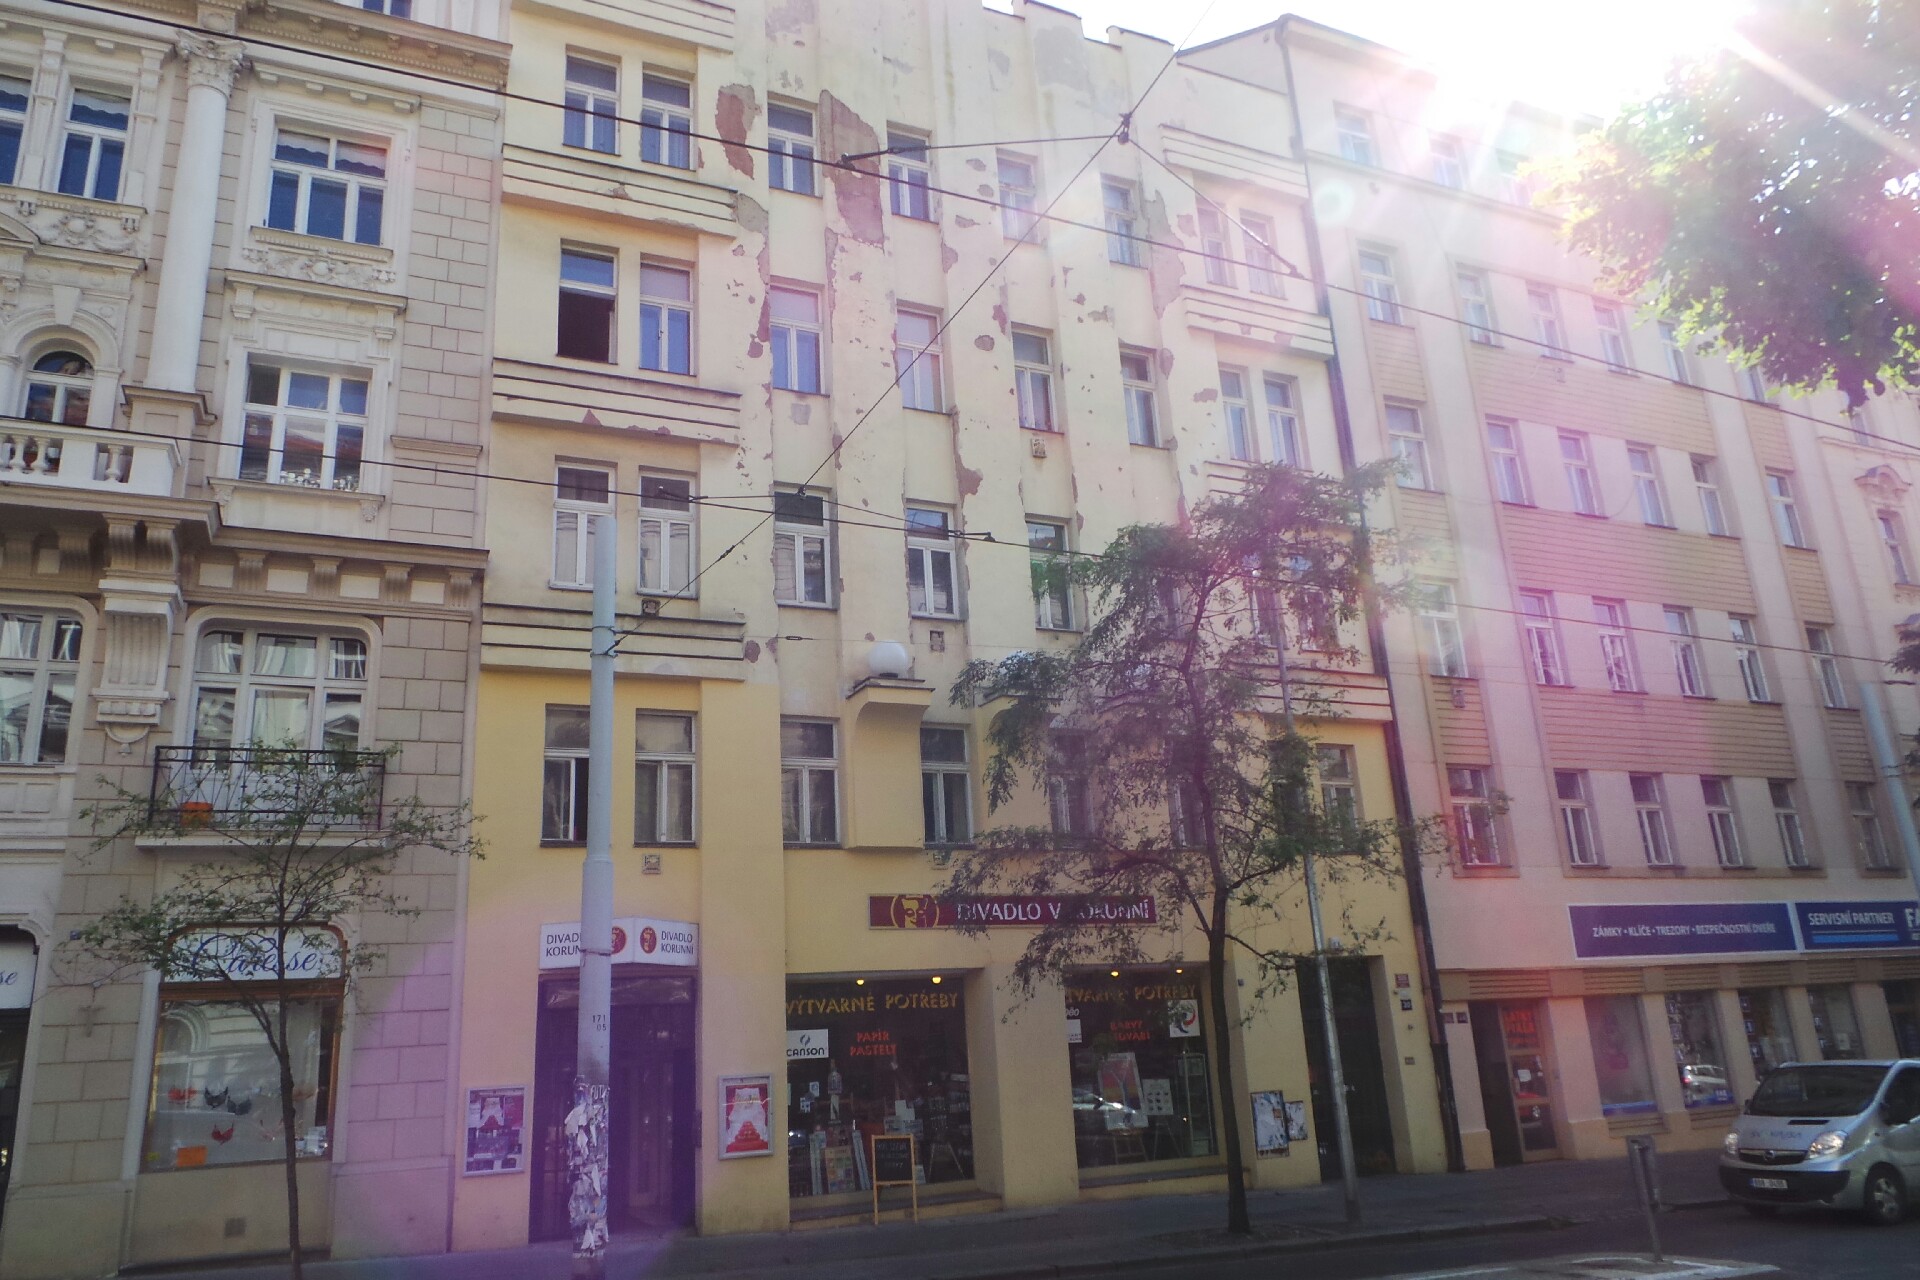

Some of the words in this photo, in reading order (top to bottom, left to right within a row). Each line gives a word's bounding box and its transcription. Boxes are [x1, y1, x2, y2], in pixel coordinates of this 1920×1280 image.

[957, 902, 1041, 920] DIVADLO
[1048, 902, 1061, 920] V
[1808, 910, 1851, 926] SERVISNÍ
[1852, 911, 1895, 925] PARTNER
[661, 931, 693, 942] DIVADLO
[1656, 925, 1690, 936] TREZORY
[547, 933, 581, 944] DIVAD
[546, 945, 580, 957] KORUN
[886, 990, 958, 1009] POTŘEBY
[850, 1044, 896, 1056] PASTELY
